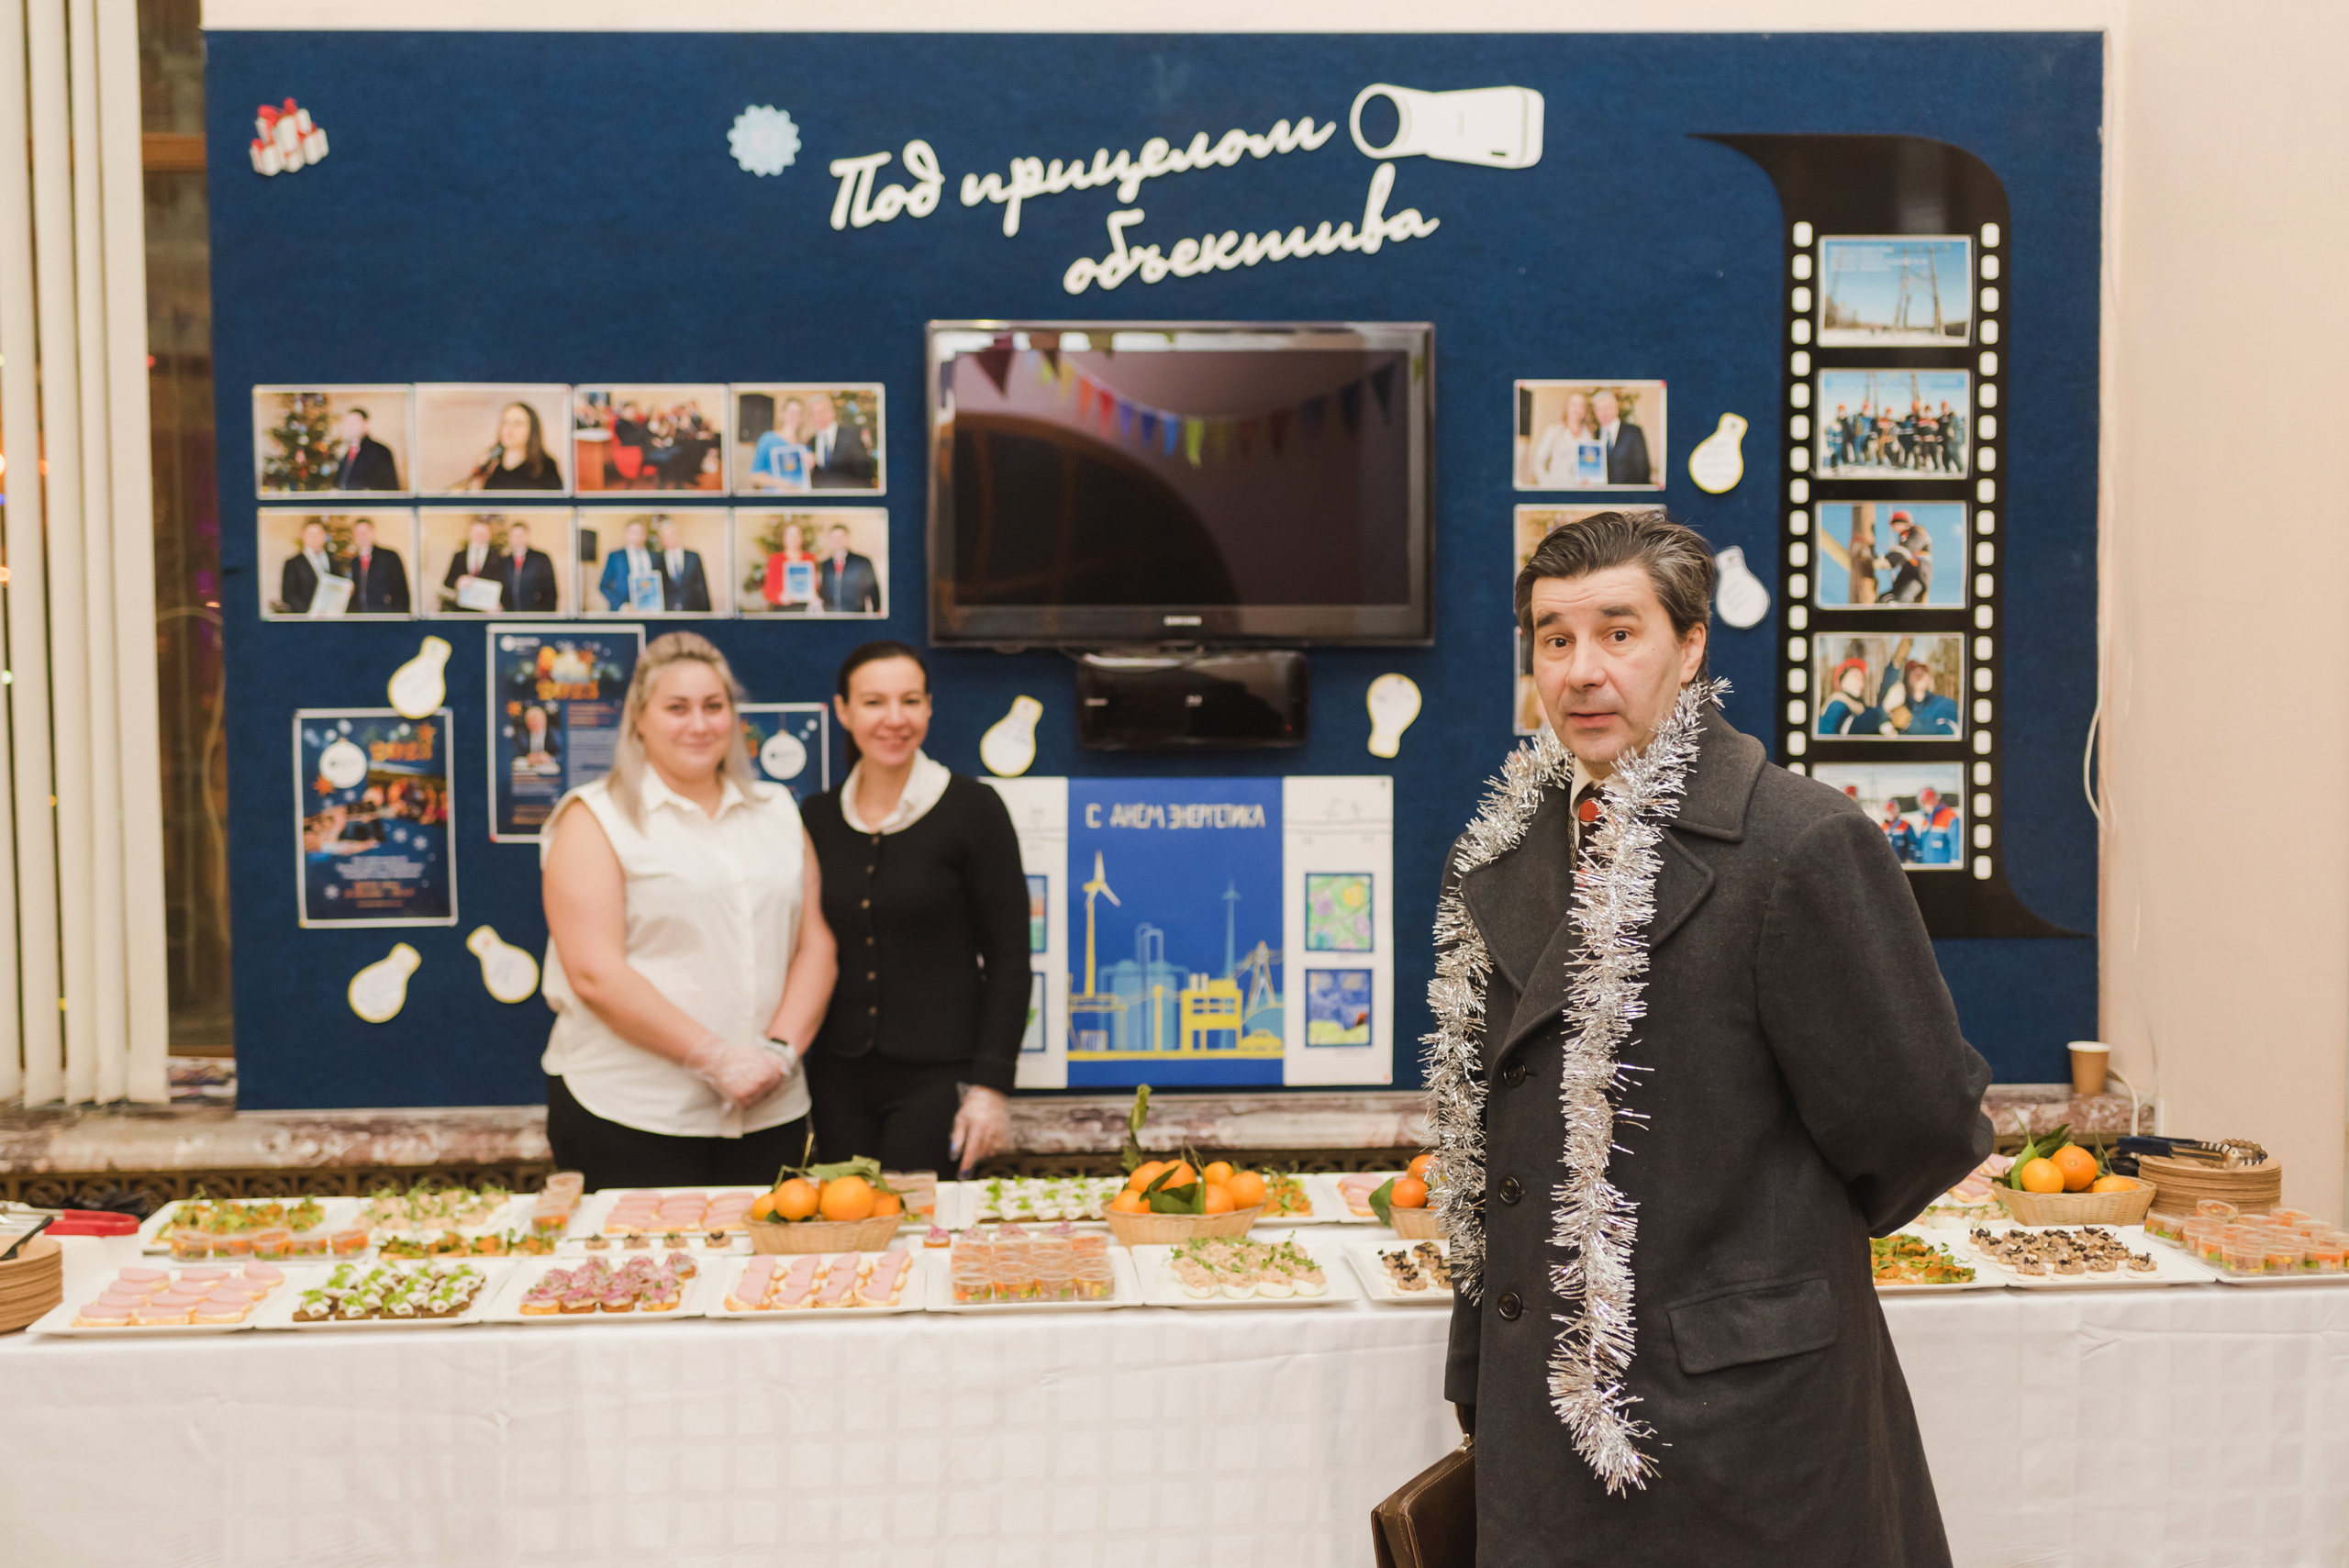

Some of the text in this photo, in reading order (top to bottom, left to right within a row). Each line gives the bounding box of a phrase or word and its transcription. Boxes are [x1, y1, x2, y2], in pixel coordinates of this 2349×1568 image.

[829, 117, 1337, 237] Под прицелом
[1063, 162, 1441, 295] объектива
[1085, 803, 1101, 828] С
